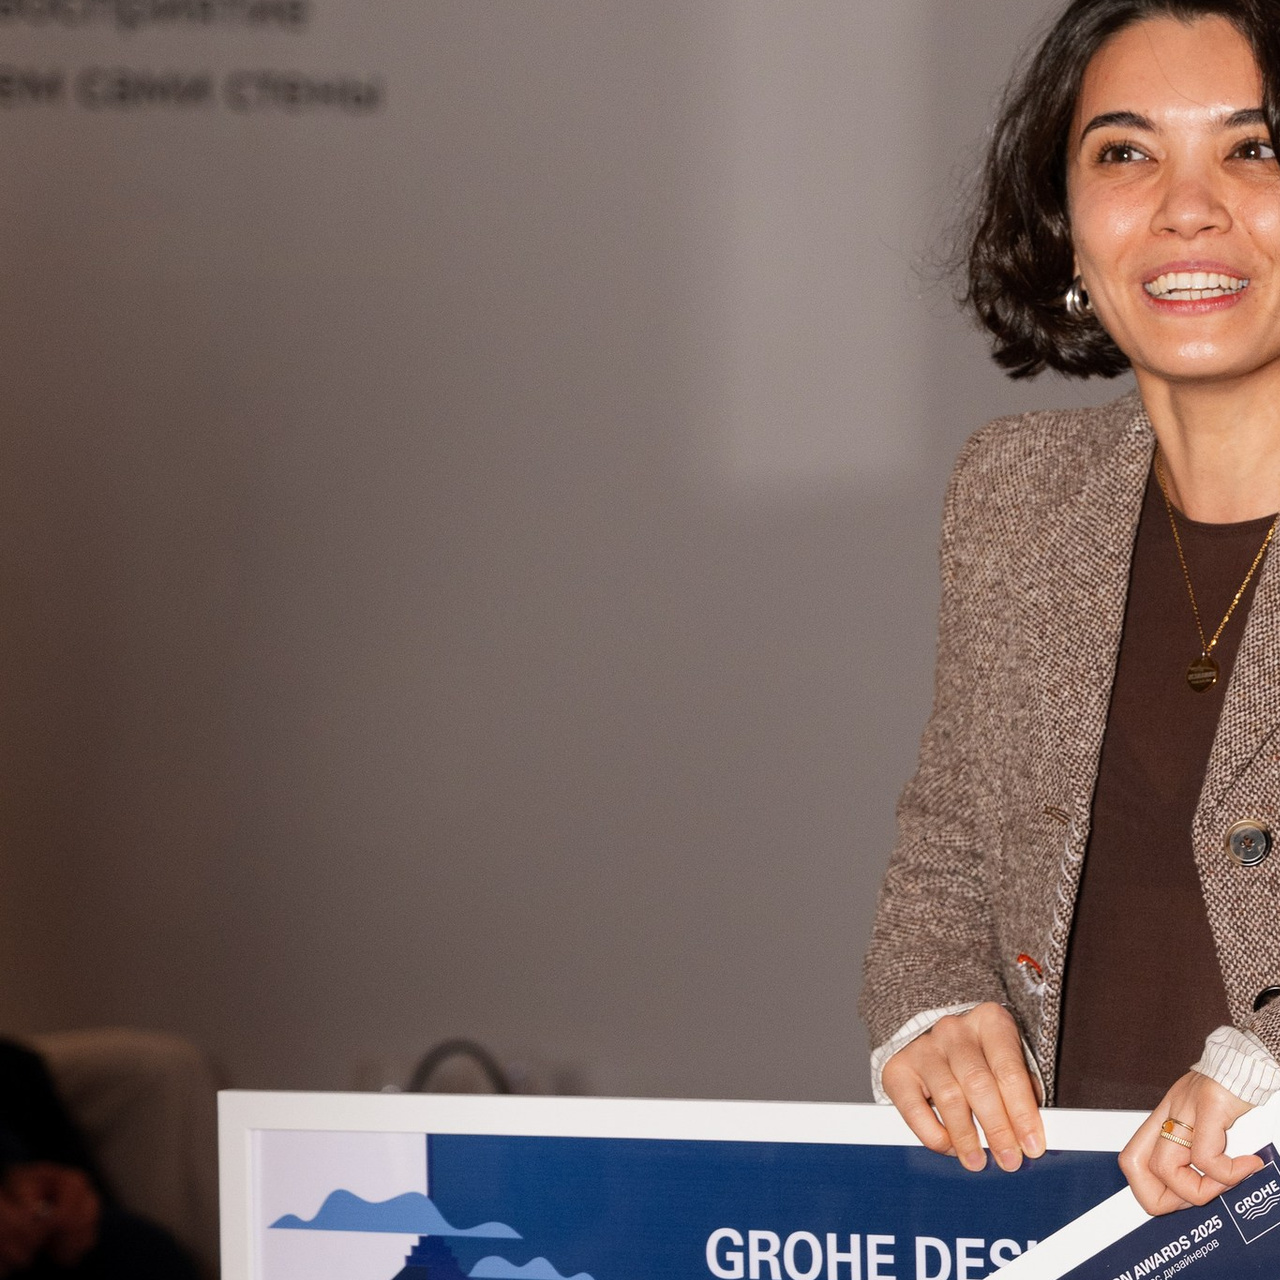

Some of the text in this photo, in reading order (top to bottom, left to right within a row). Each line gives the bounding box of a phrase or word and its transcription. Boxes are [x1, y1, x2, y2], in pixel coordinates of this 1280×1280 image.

[1234, 1179, 1280, 1214] GROHE
[1133, 1235, 1191, 1280] AWARDS
[1190, 1214, 1223, 1244] 2025
